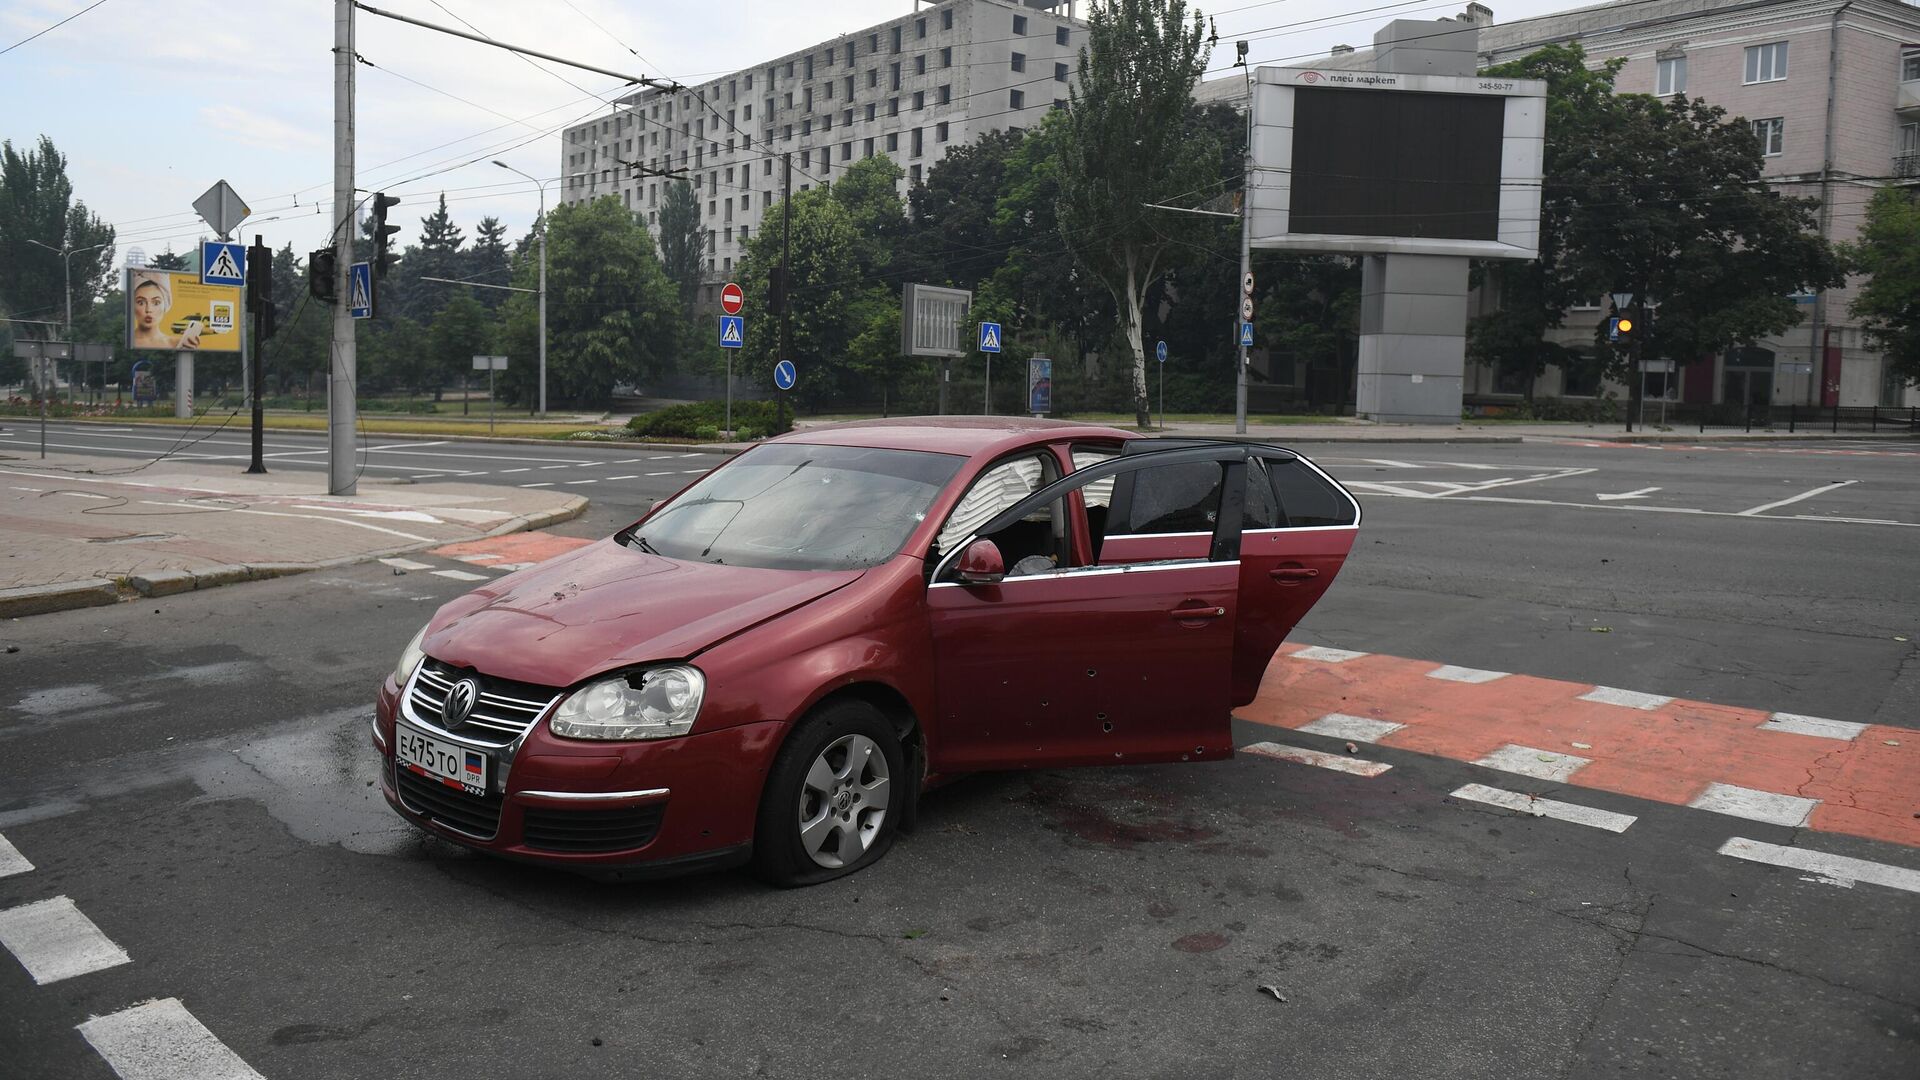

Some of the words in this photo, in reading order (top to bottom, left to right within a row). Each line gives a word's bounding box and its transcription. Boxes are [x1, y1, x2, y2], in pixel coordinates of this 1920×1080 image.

[1330, 73, 1353, 83] плей
[1356, 75, 1396, 86] маркет
[1478, 82, 1513, 91] 345-50-77
[467, 773, 481, 784] DPR
